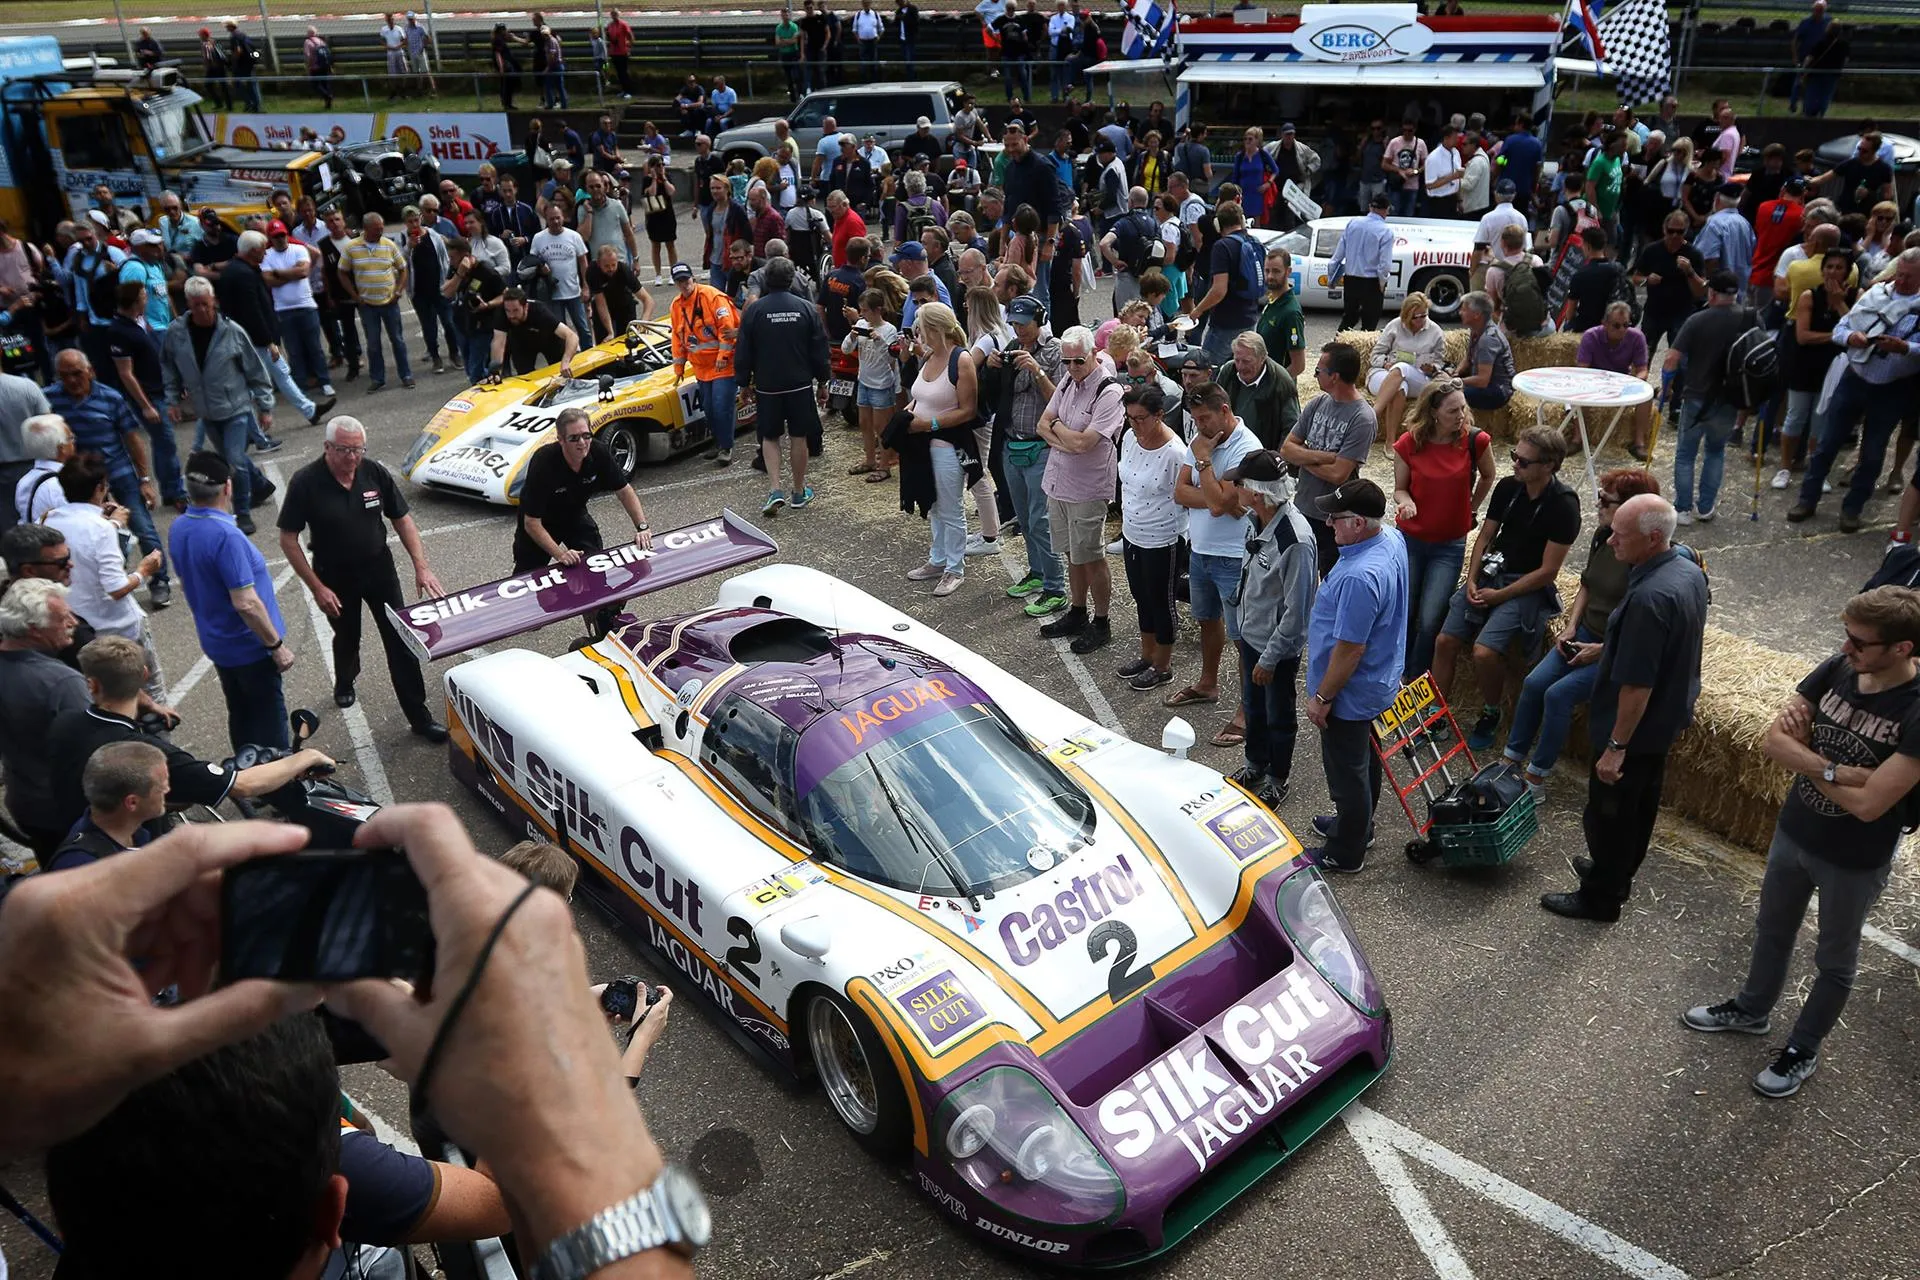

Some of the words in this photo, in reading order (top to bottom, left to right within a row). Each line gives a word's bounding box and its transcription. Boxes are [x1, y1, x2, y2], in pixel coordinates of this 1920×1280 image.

[1321, 33, 1376, 47] BERG
[264, 126, 293, 140] Shell
[428, 125, 460, 139] Shell
[431, 140, 500, 160] HELIX
[1413, 250, 1473, 267] VALVOLIN
[591, 412, 613, 430] HILIPS
[613, 403, 654, 417] AUTORADIO
[681, 390, 705, 416] 14
[498, 411, 557, 433] 140
[428, 467, 450, 476] PHILIPS
[449, 471, 488, 484] AUTORADIO
[429, 447, 510, 479] CAMEL
[586, 541, 658, 573] Silk
[663, 523, 726, 549] Cut
[409, 592, 490, 626] Silk
[496, 569, 567, 599] Cut
[840, 679, 957, 745] JAGUAR
[1180, 792, 1215, 816] P&O
[526, 751, 607, 855] Silk
[620, 825, 703, 938] Cut
[1234, 824, 1267, 850] CUT
[918, 895, 933, 911] E
[999, 853, 1144, 966] Castrol
[648, 914, 737, 1018] JAGUAR
[726, 916, 762, 990] 2
[1087, 919, 1156, 1005] 2
[870, 957, 915, 986] P&O
[910, 977, 961, 1016] SILK
[929, 997, 971, 1032] CUT
[1098, 1047, 1231, 1158] Silk
[1222, 969, 1330, 1065] Cut
[1173, 1044, 1323, 1173] JAGUAR
[919, 1172, 968, 1220] TWR
[975, 1216, 1070, 1254] DUNLOP
